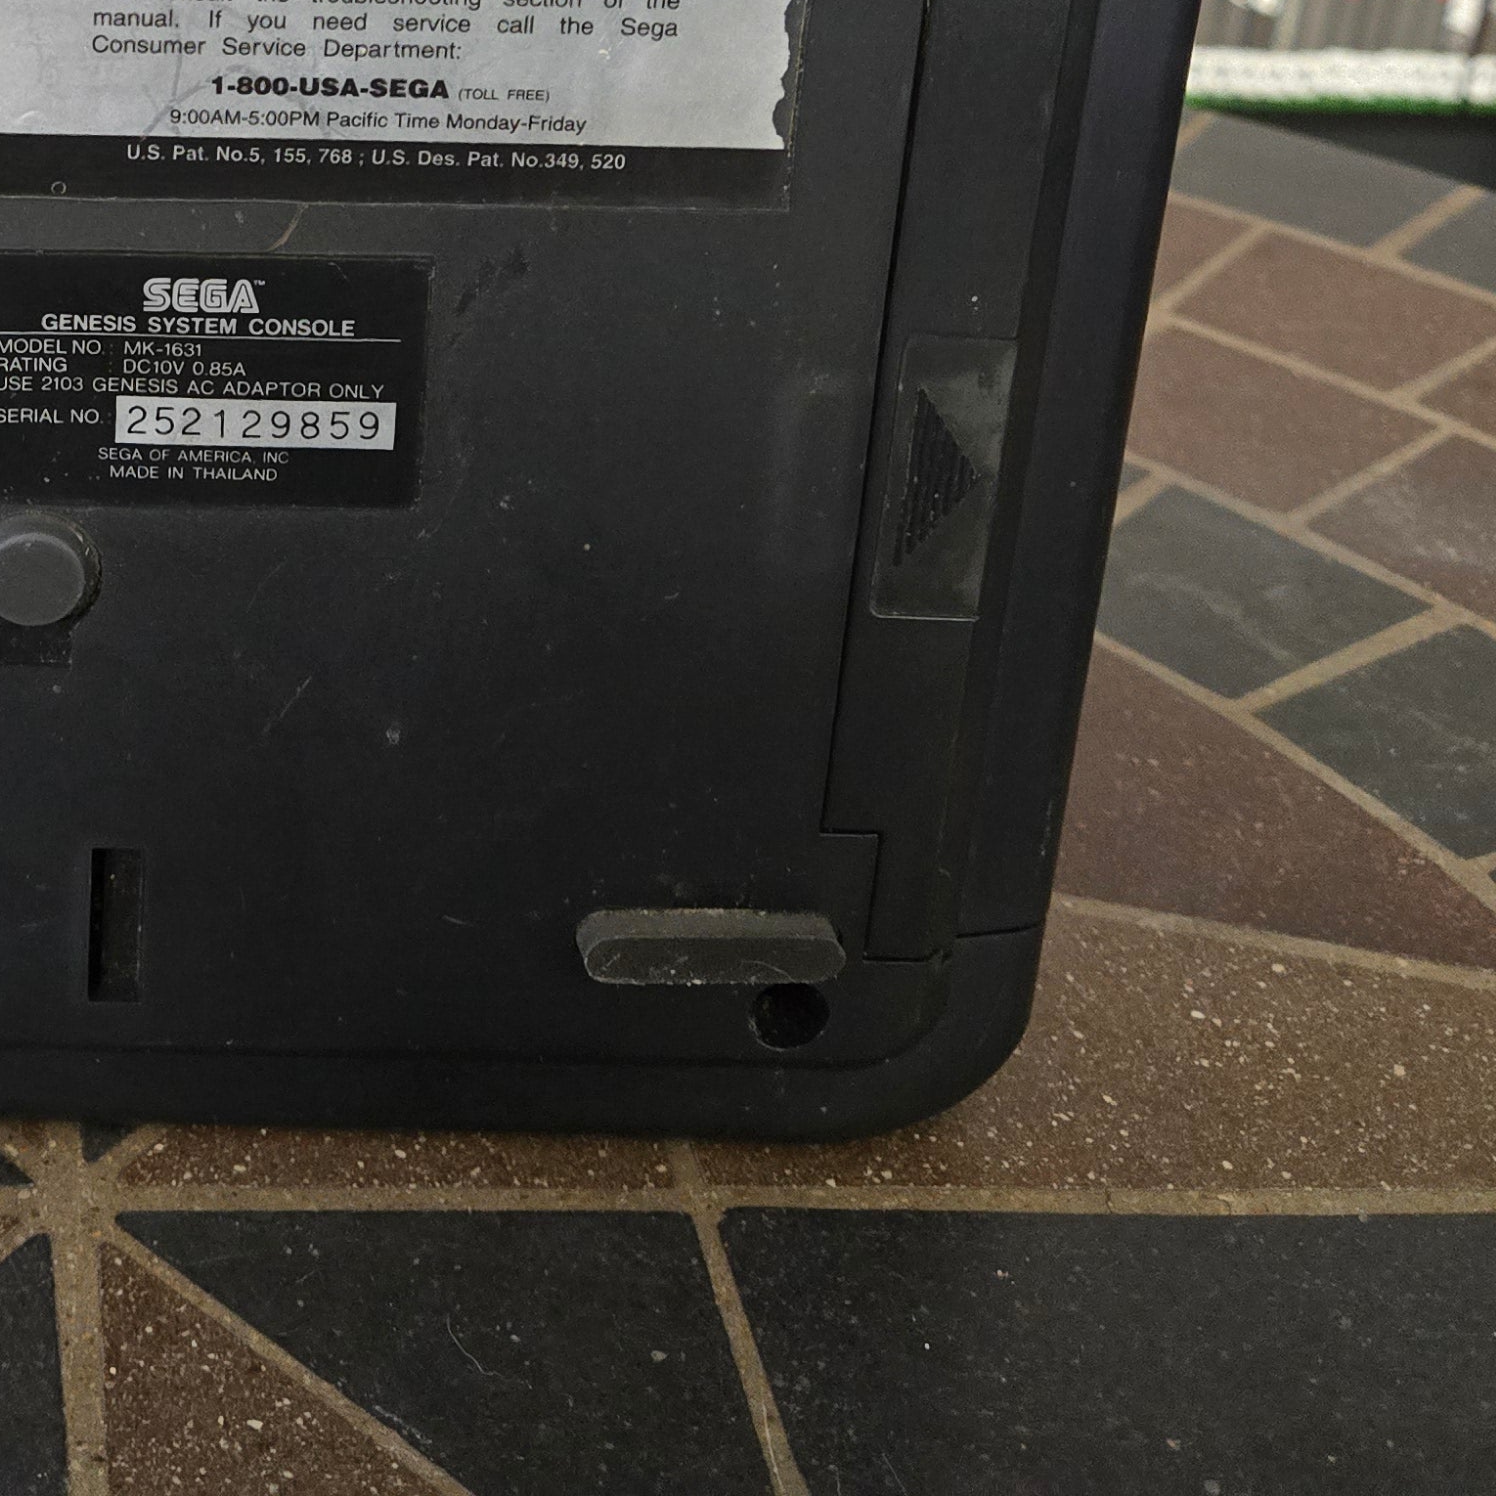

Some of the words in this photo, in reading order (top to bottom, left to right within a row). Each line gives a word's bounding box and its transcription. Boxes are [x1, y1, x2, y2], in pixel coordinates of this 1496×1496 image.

[93, 8, 179, 28] manual.
[247, 14, 286, 33] you
[313, 12, 368, 31] need
[392, 13, 471, 33] service
[497, 14, 534, 34] call
[560, 16, 594, 35] the
[620, 17, 678, 41] Sega
[92, 34, 206, 55] Consumer
[221, 36, 306, 57] Service
[323, 38, 461, 62] Department:
[211, 75, 449, 99] 1-800-USA-SEGA
[458, 87, 499, 101] (TOLL
[507, 88, 550, 103] FREE)
[170, 106, 320, 126] 9:00AM-5:00PM
[326, 111, 388, 128] Pacific
[394, 111, 440, 129] Time
[446, 113, 587, 136] Monday-Friday
[127, 144, 165, 160] U.S.
[172, 144, 208, 161] Pat.
[216, 145, 265, 164] No.5,
[274, 147, 311, 164] 155,
[318, 148, 352, 164] 768
[371, 149, 409, 165] U.S.
[417, 150, 459, 166] Des.
[467, 151, 503, 167] Pat.
[511, 151, 583, 170] No.349,
[590, 153, 625, 170] 520
[142, 276, 261, 314] SEGA
[40, 313, 138, 334] GENESIS
[146, 315, 237, 337] SYSTEM
[247, 317, 356, 338] CONSOLE
[124, 340, 201, 357] MK-1631
[123, 358, 184, 375] DC10V
[192, 361, 246, 376] 0.85A
[41, 376, 83, 391] 2103
[92, 377, 178, 396] GENESIS
[187, 379, 214, 395] AC
[222, 380, 321, 397] ADAPTOR
[329, 383, 384, 399] ONLY
[127, 405, 379, 440] 252129859
[97, 446, 142, 460] SEGA
[110, 464, 159, 479] MADE
[192, 466, 277, 481] THAILAND
